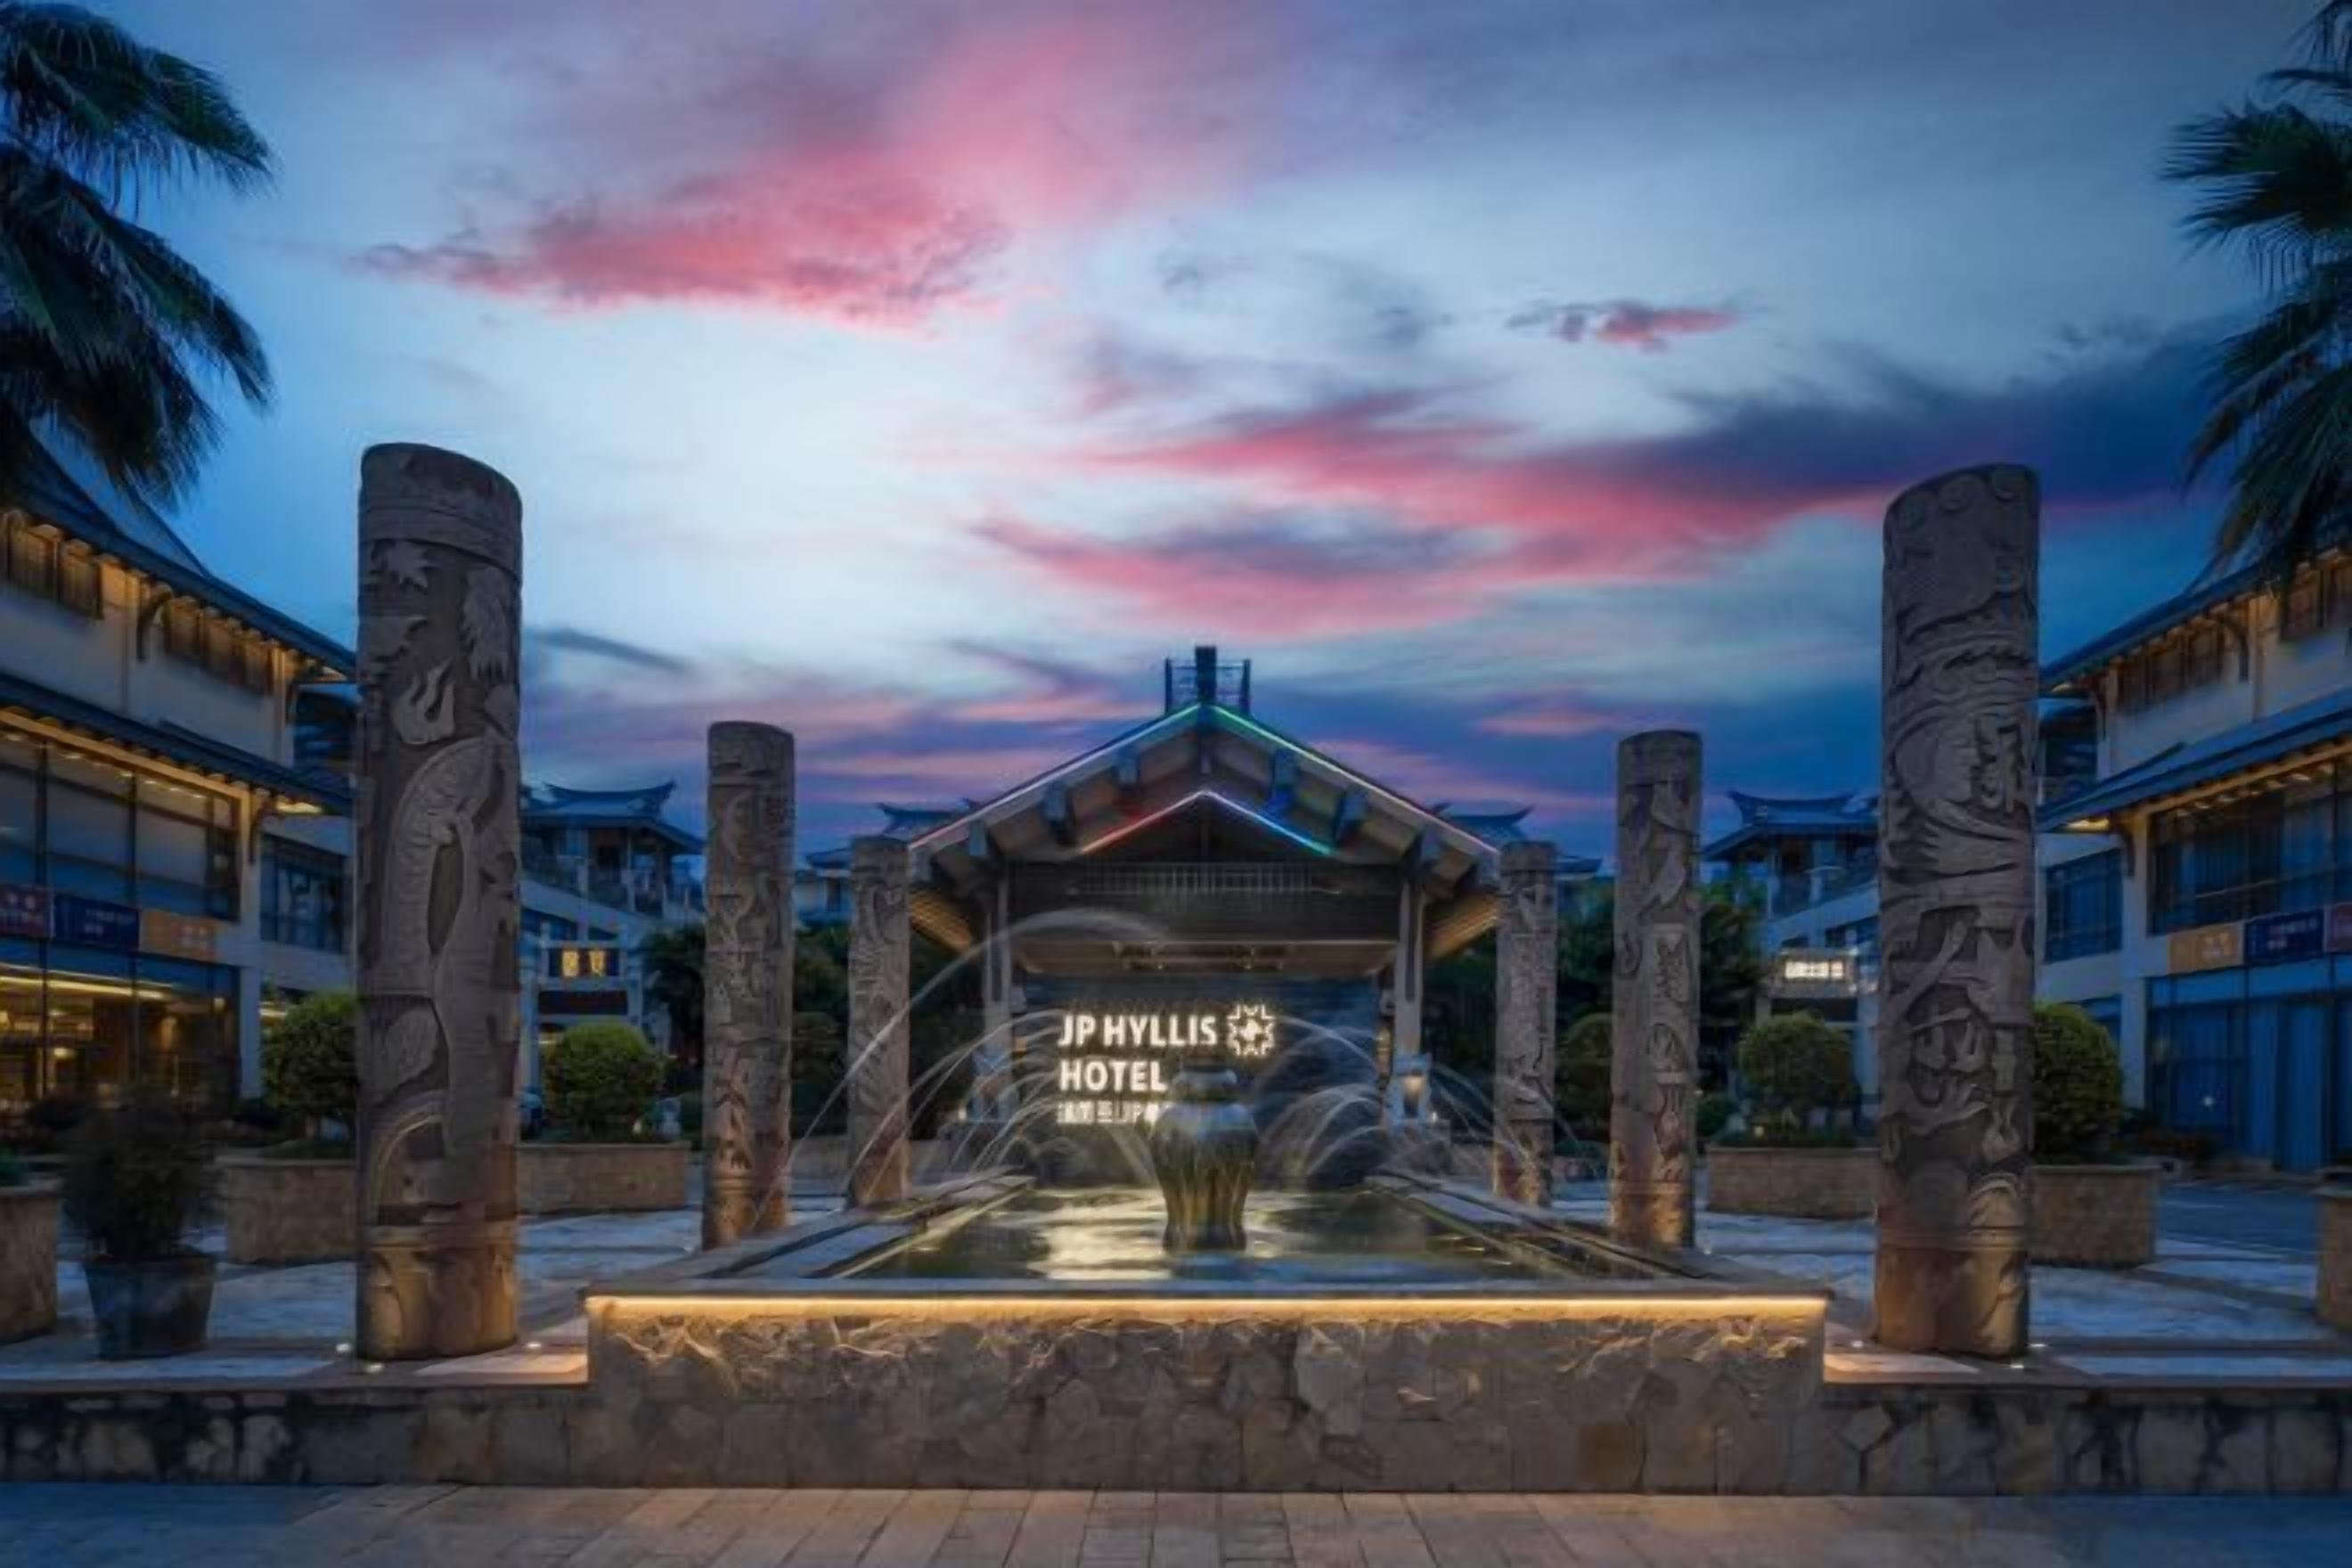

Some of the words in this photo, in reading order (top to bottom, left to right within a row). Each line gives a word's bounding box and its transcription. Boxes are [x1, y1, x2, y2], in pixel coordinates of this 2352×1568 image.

[1058, 1015, 1096, 1047] JP
[1103, 1015, 1218, 1047] HYLLIS
[1059, 1060, 1168, 1092] HOTEL
